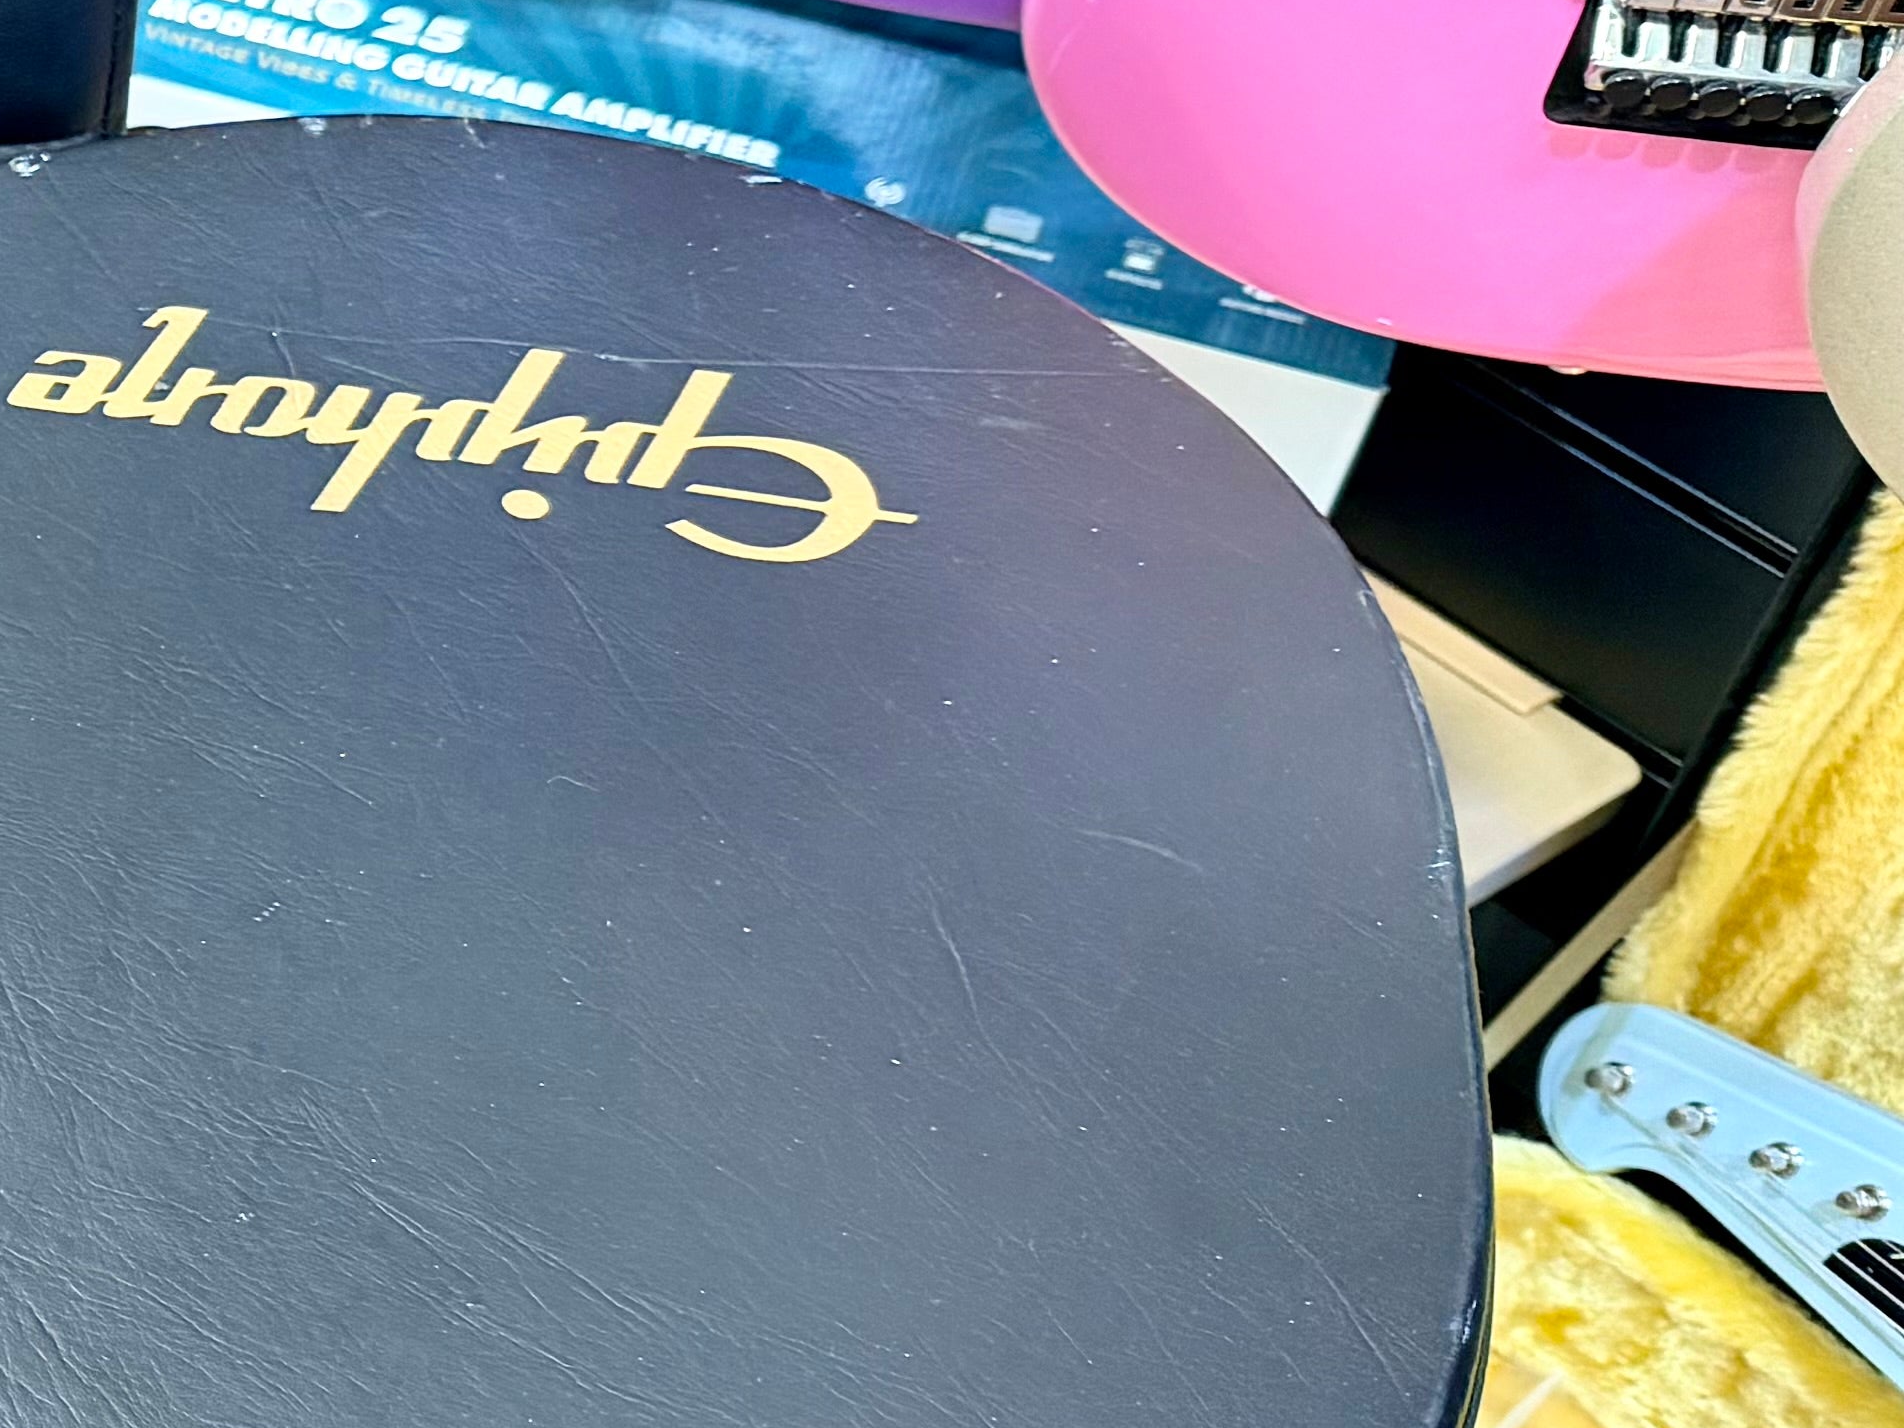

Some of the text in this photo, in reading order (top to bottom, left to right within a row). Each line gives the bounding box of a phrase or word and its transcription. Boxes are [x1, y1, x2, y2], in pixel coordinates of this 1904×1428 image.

[370, 4, 472, 55] 25
[334, 71, 358, 92] &
[391, 52, 555, 112] GUITAR
[548, 90, 782, 170] AMPLIFIER
[7, 305, 919, 564] Epiphone
